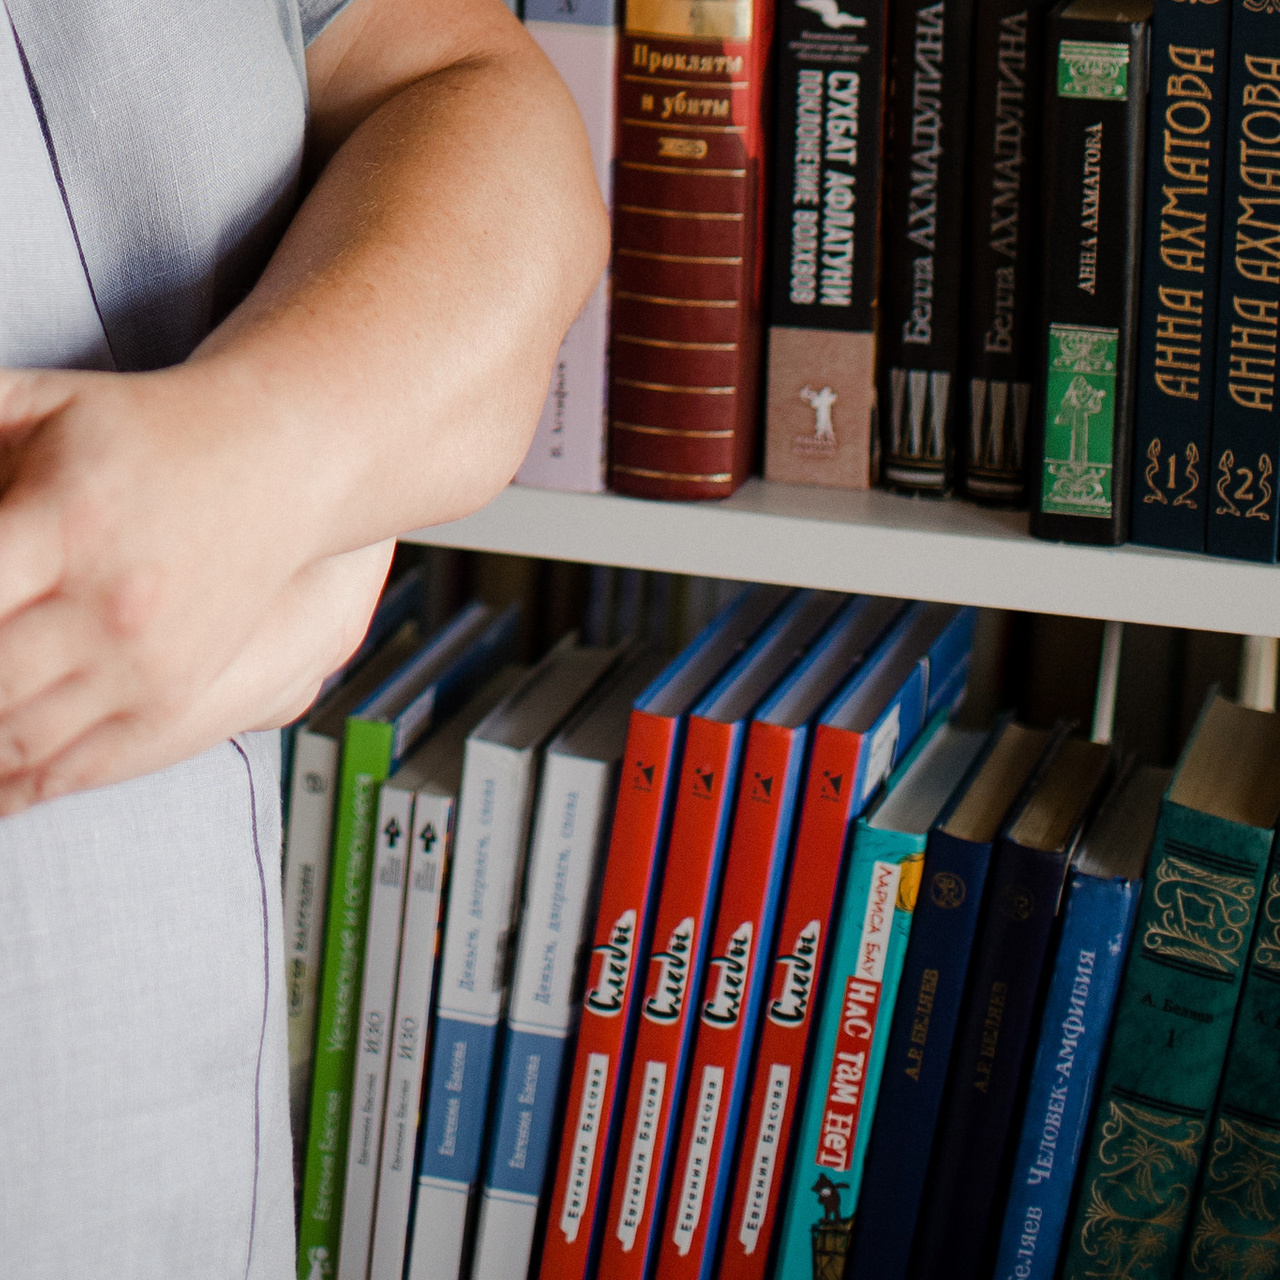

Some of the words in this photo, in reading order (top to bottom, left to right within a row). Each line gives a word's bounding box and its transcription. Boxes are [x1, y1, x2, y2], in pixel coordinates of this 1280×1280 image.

[632, 43, 744, 74] Прокляты
[641, 93, 654, 112] и
[660, 90, 730, 120] убиты
[794, 68, 824, 206] ПОКЛОНЕНИЕ
[824, 69, 861, 168] СУХБАТ
[906, 0, 945, 251] АХМАДУЛИНА
[990, 10, 1028, 258] АХМАДУЛИНА
[1080, 121, 1103, 233] АХМАТОВА
[1159, 43, 1215, 274] АХМАТОВА
[1236, 52, 1280, 286] АХМАТОВА
[789, 208, 819, 306] ВОЛХВОВ
[819, 169, 858, 308] АФЛАТУНИ
[1077, 235, 1098, 296] АННА
[902, 255, 934, 346] Белла
[1155, 284, 1204, 401] АННА
[1228, 294, 1279, 411] АННА
[1166, 453, 1178, 489] 1
[1234, 467, 1254, 501] 2
[868, 863, 894, 935] ЛАРИСА
[843, 980, 879, 1041] НАС
[1026, 948, 1097, 1186] ЧЕЛОВЕК-АМФИБИЯ
[566, 1143, 591, 1220] Евгения
[581, 1067, 603, 1133] Басова
[623, 1151, 648, 1228] Евгения
[639, 1075, 661, 1142] Басова
[679, 1156, 704, 1233] Евгения
[696, 1080, 719, 1145] Басова
[746, 1155, 771, 1231] Евгения
[763, 1077, 786, 1143] Басова
